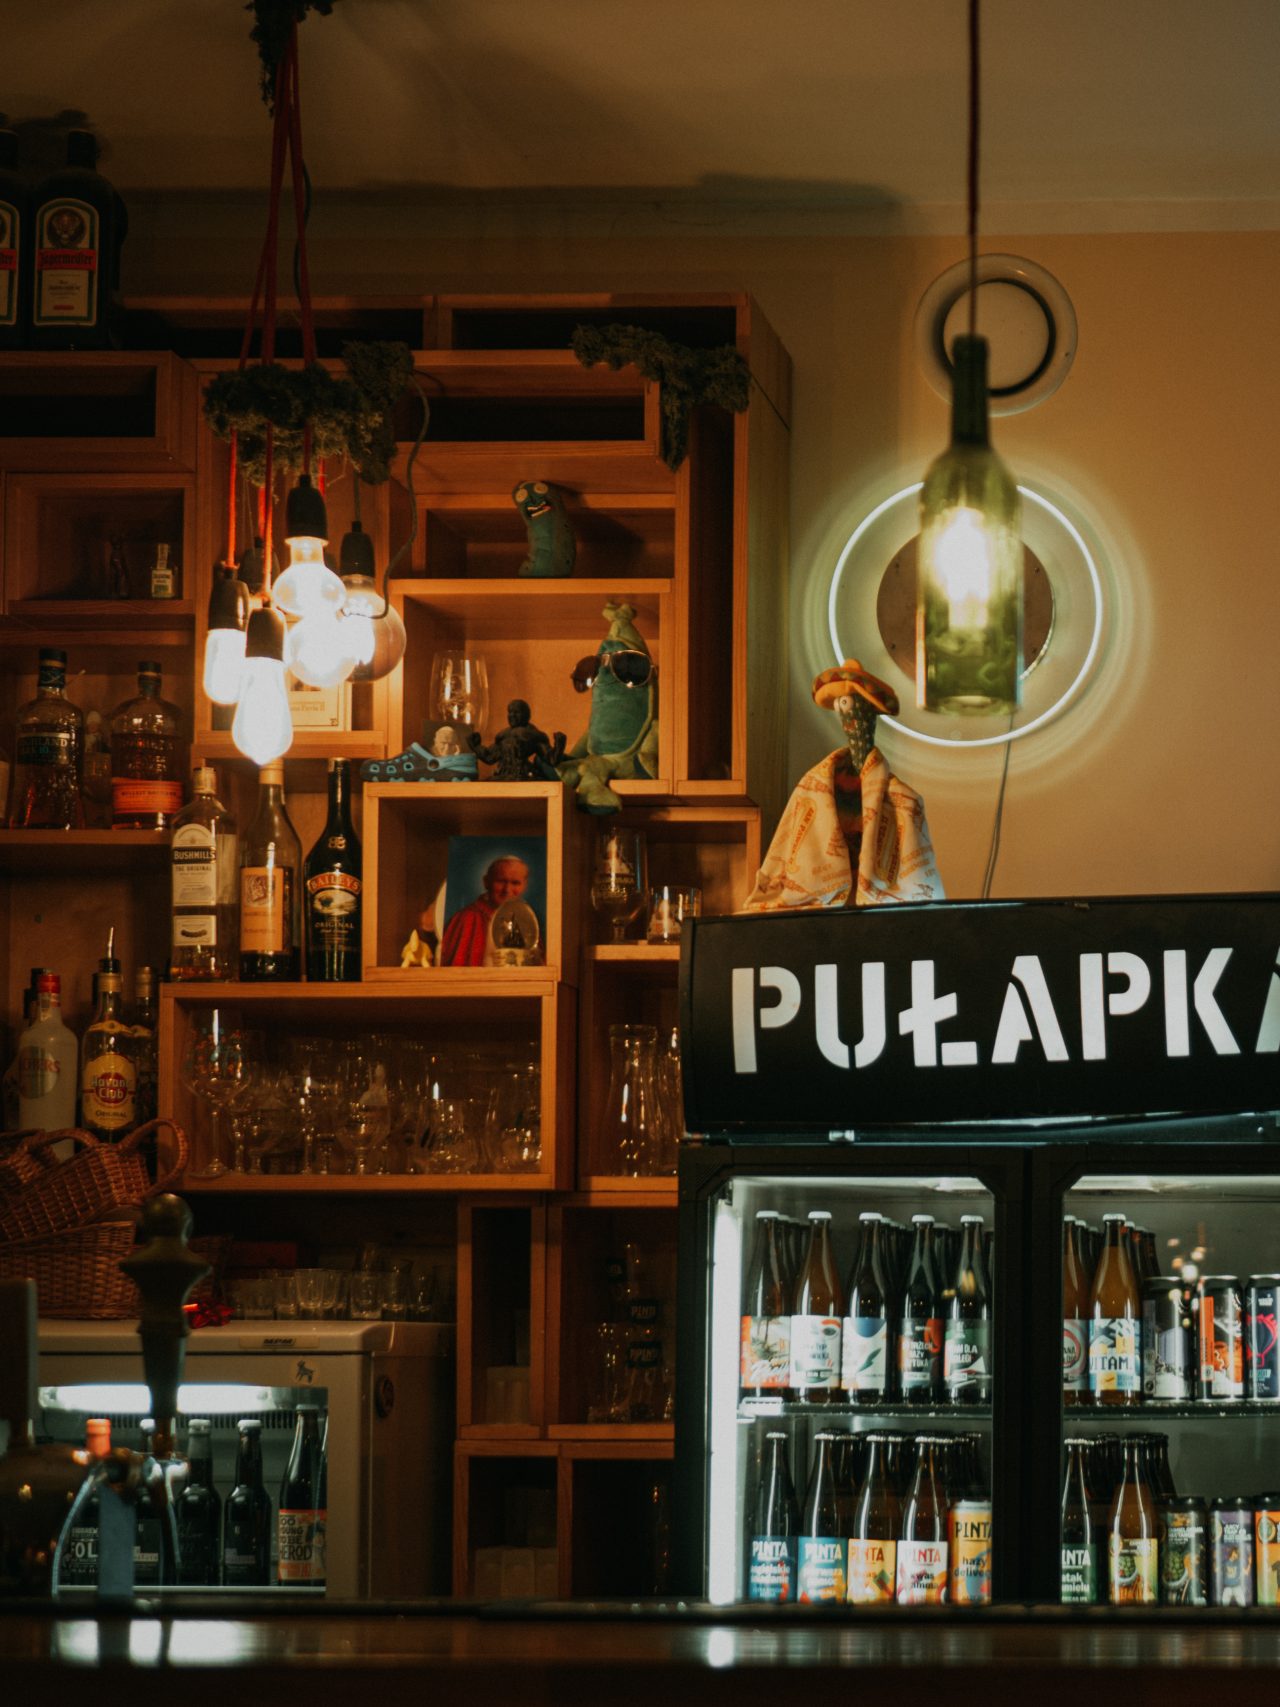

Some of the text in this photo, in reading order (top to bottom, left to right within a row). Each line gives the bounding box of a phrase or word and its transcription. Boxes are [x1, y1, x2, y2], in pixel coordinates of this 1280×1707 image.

[174, 851, 215, 860] BUSHMILLS
[310, 873, 361, 890] BAILEYS
[99, 1087, 125, 1099] Club
[280, 1517, 296, 1526] OO
[955, 1521, 992, 1538] PINTA
[71, 1541, 98, 1557] FOL
[752, 1540, 788, 1557] PINTA
[804, 1543, 842, 1559] PINTA
[850, 1546, 885, 1562] PNTA
[904, 1548, 941, 1563] INTA
[1062, 1549, 1091, 1566] INTA
